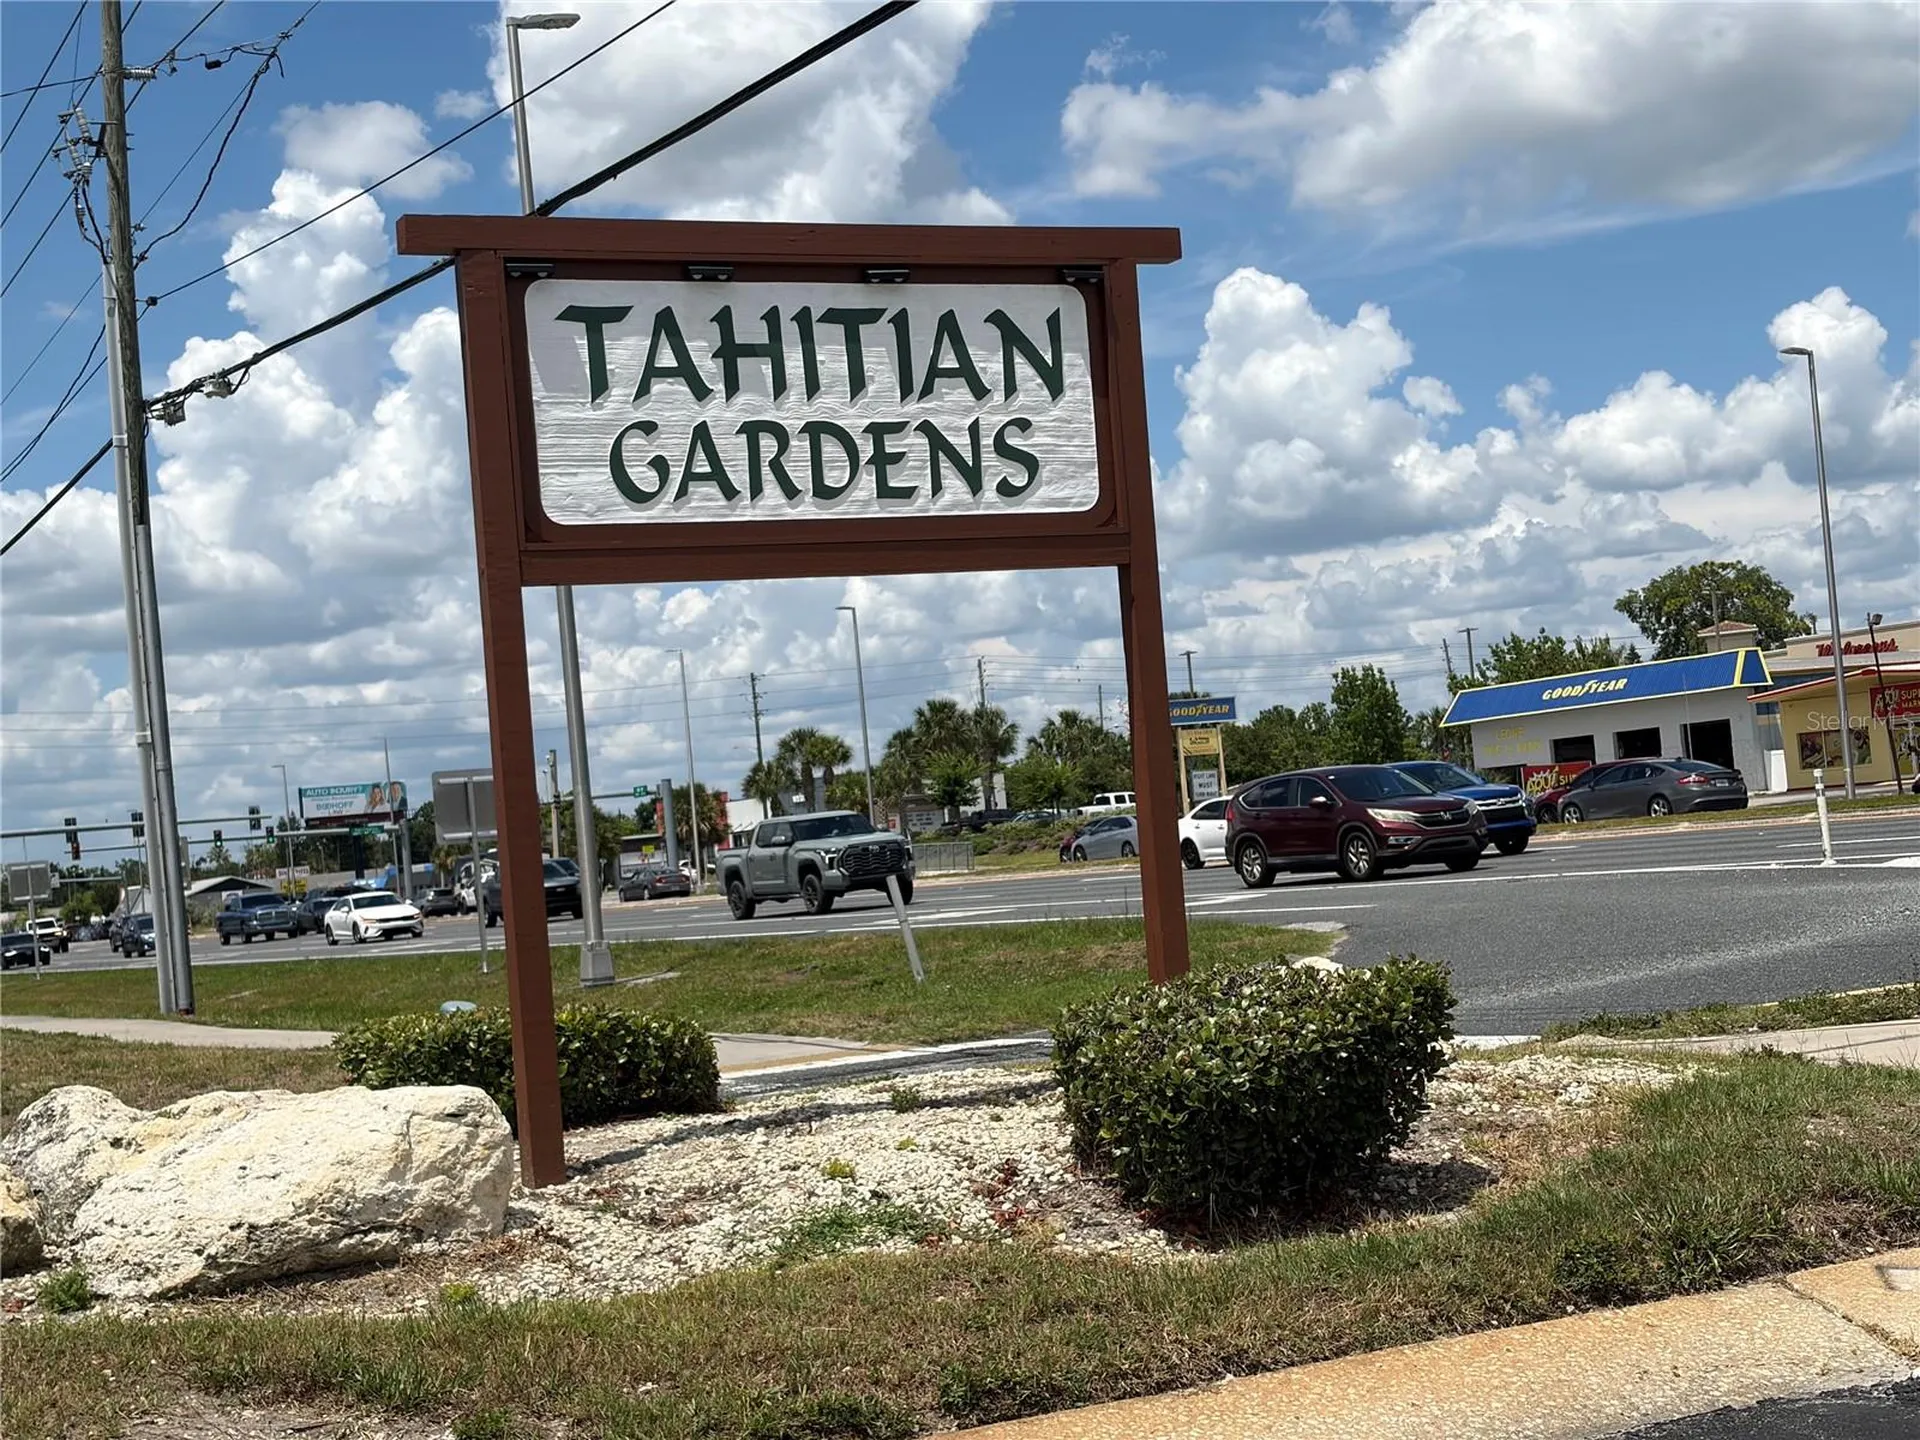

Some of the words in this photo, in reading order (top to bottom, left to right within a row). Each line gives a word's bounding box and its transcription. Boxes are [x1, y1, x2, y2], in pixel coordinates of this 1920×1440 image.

[555, 304, 1066, 404] TAHITIAN
[608, 416, 1041, 505] GARDENS
[1816, 638, 1899, 657] Wlgreens
[1542, 678, 1627, 700] GOODYEAR
[1169, 703, 1230, 718] OODYEAR
[306, 788, 329, 797] AUTO
